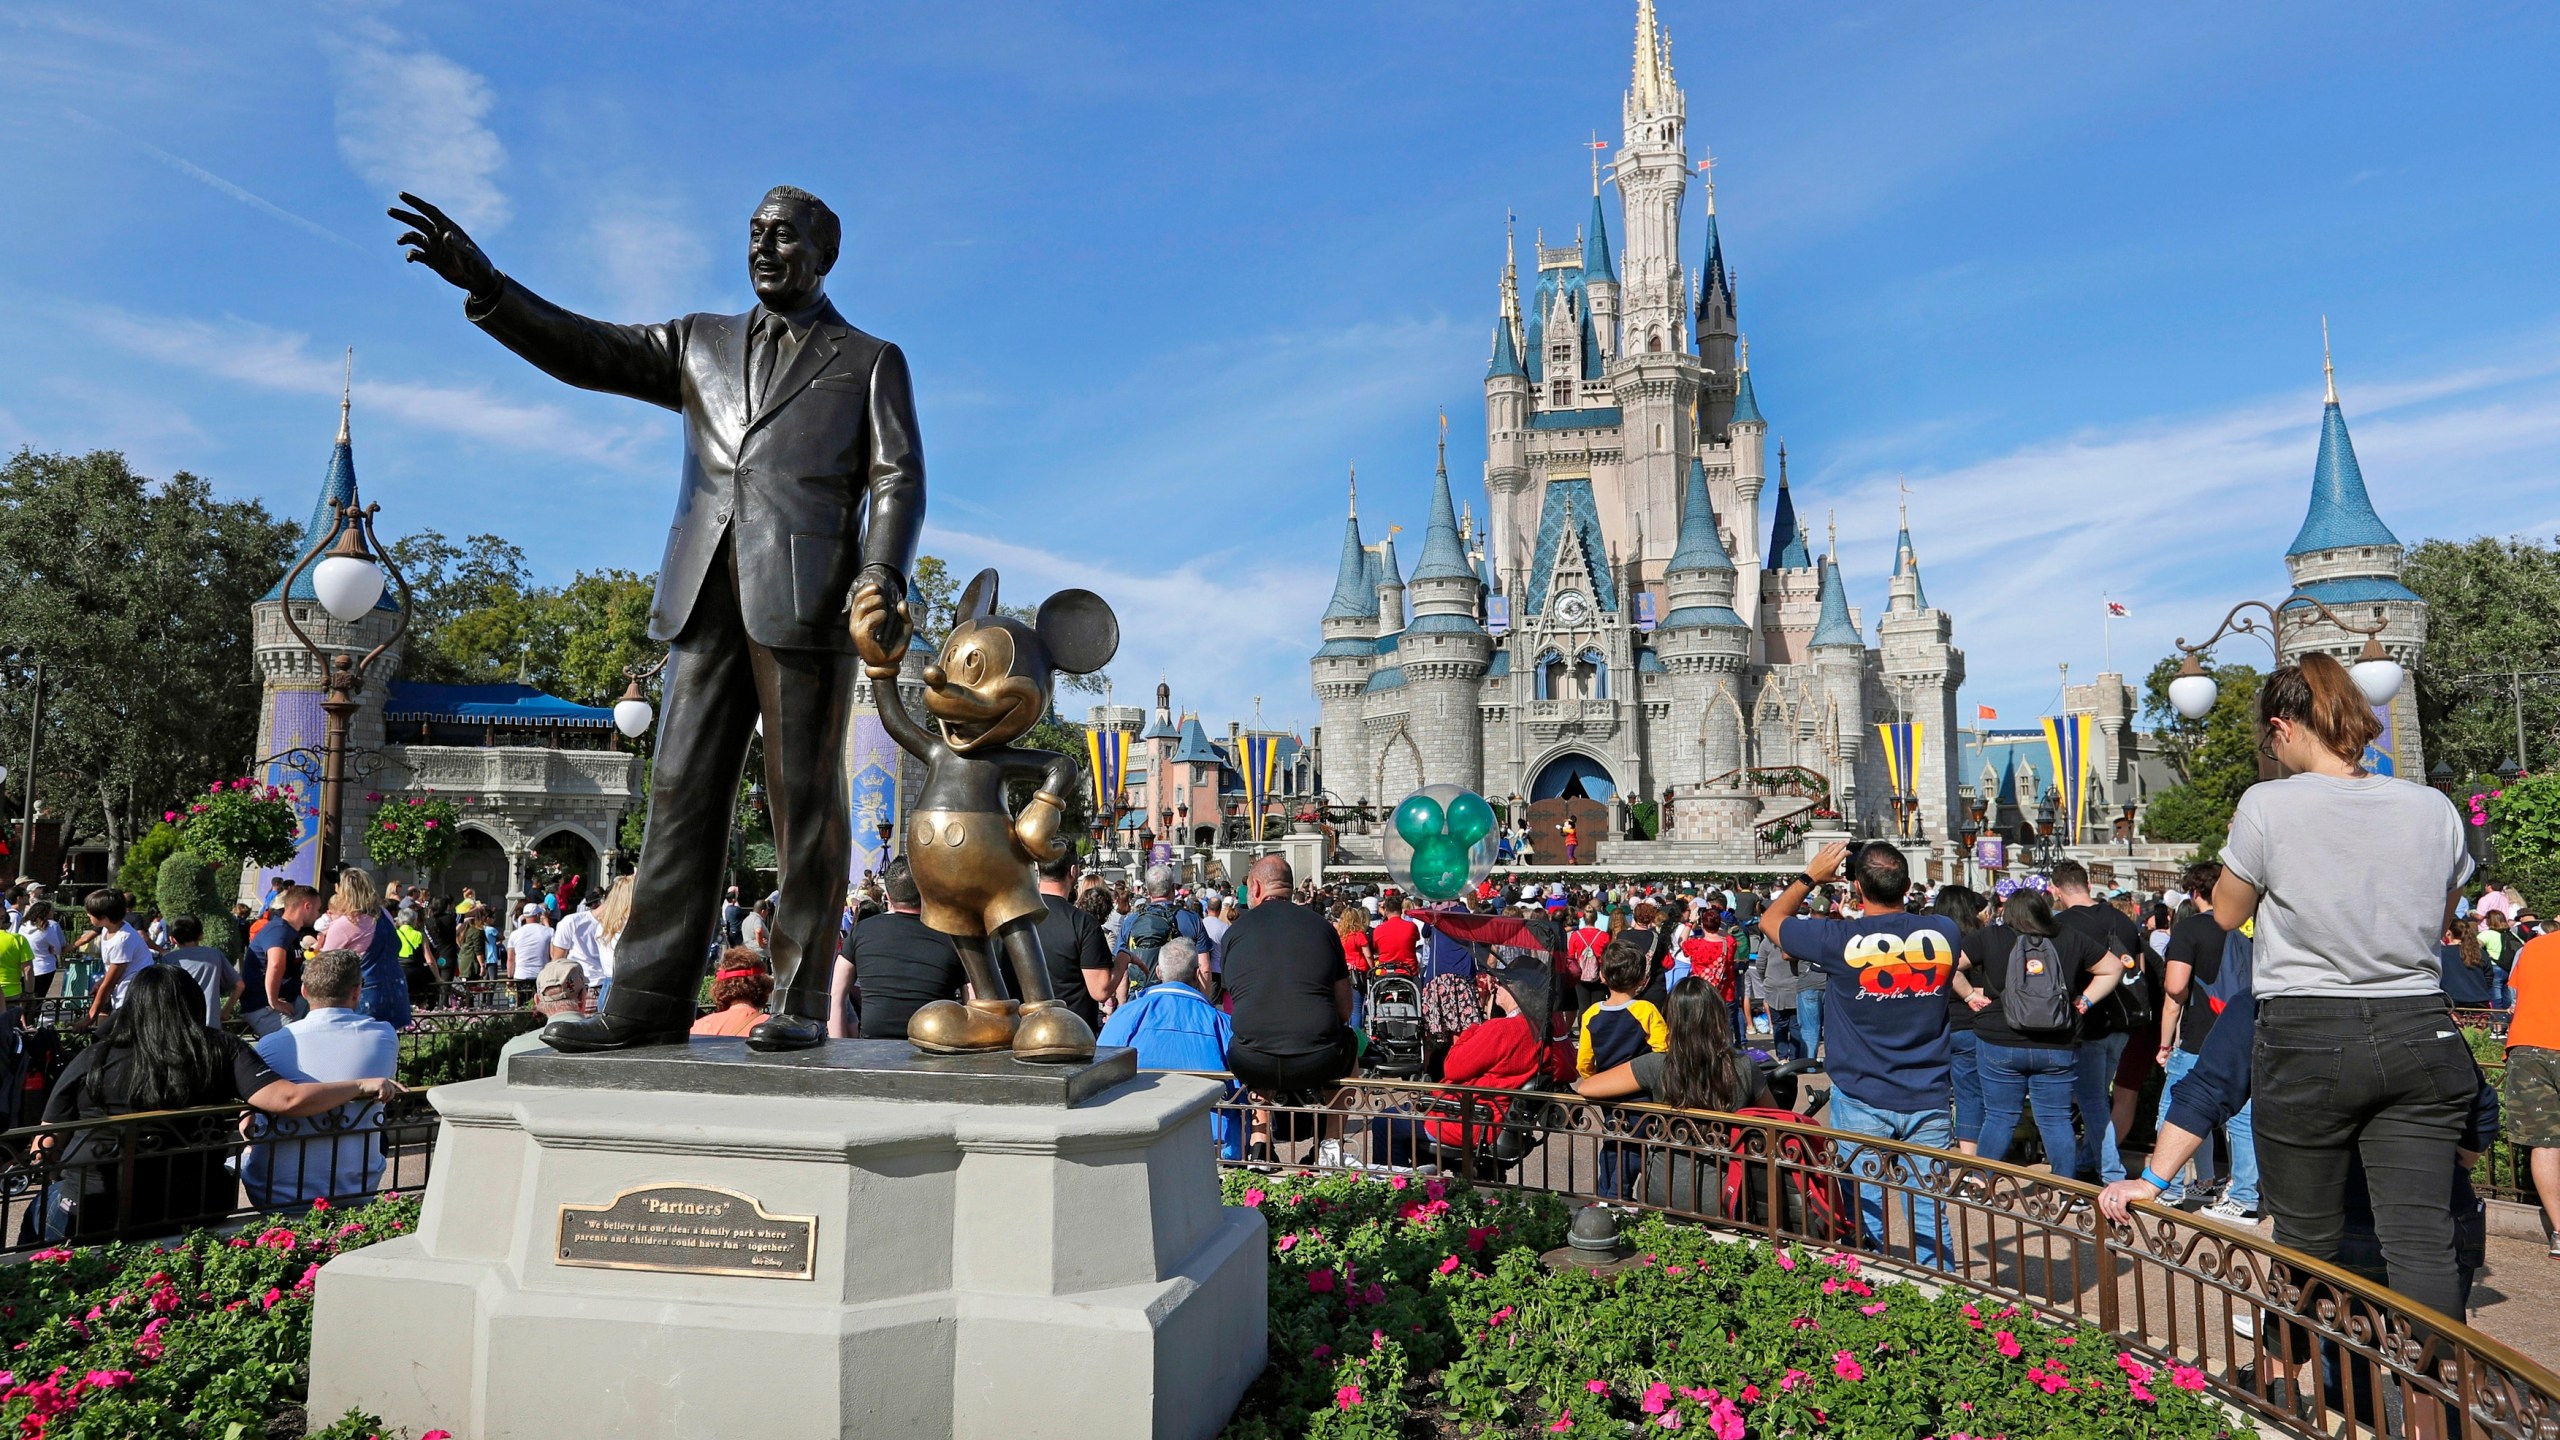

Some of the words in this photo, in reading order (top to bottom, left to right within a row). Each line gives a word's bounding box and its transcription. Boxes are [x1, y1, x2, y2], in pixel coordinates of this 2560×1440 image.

[641, 1199, 730, 1215] "Partners"
[603, 1220, 635, 1231] believe
[638, 1223, 647, 1232] in
[650, 1225, 666, 1233] our
[701, 1227, 730, 1238] family
[733, 1229, 755, 1239] park
[758, 1231, 787, 1239] where
[574, 1234, 608, 1242] parents
[630, 1236, 668, 1245] children
[671, 1238, 697, 1247] could
[699, 1239, 721, 1248] have
[723, 1241, 739, 1249] fun
